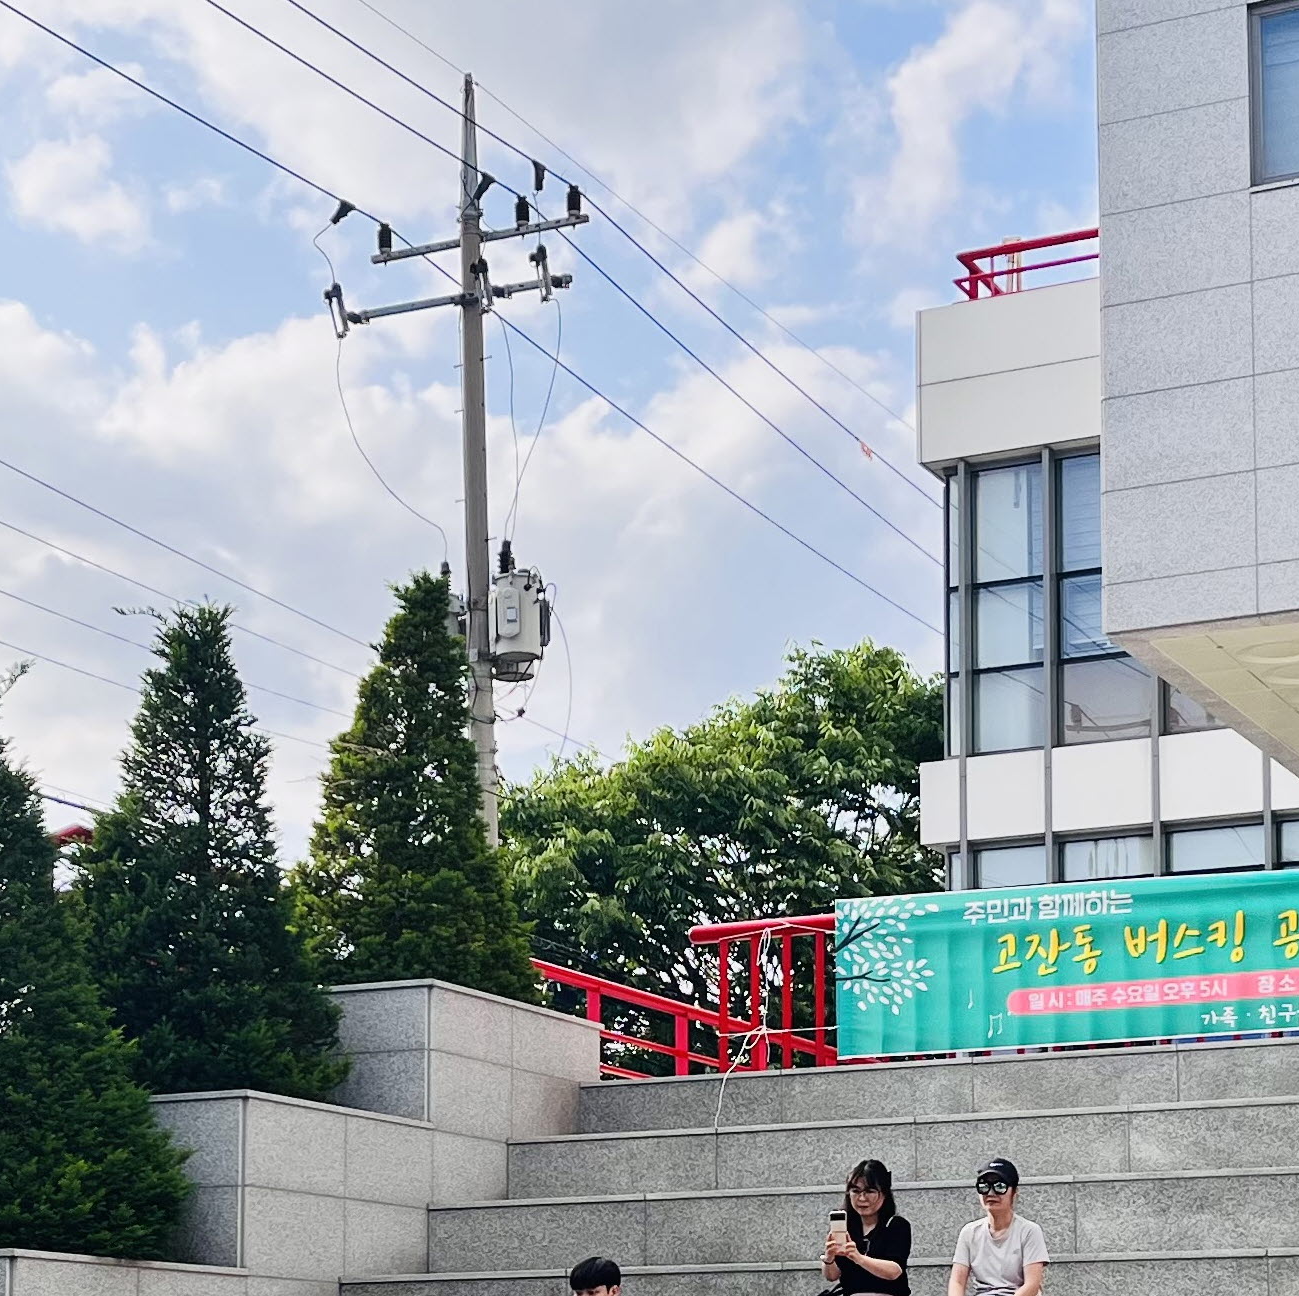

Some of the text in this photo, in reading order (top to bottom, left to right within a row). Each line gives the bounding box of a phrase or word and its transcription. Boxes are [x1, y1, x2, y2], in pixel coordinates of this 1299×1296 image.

[963, 889, 1134, 926] 주민과 함께하는
[992, 924, 1103, 976] 고잔동
[1124, 909, 1246, 965] 버스킹
[1075, 988, 1108, 1006] 매주
[1113, 984, 1160, 1004] 수요일
[1163, 982, 1196, 1001] 오후
[1200, 979, 1228, 998] 5시
[1201, 1006, 1238, 1027] 가족
